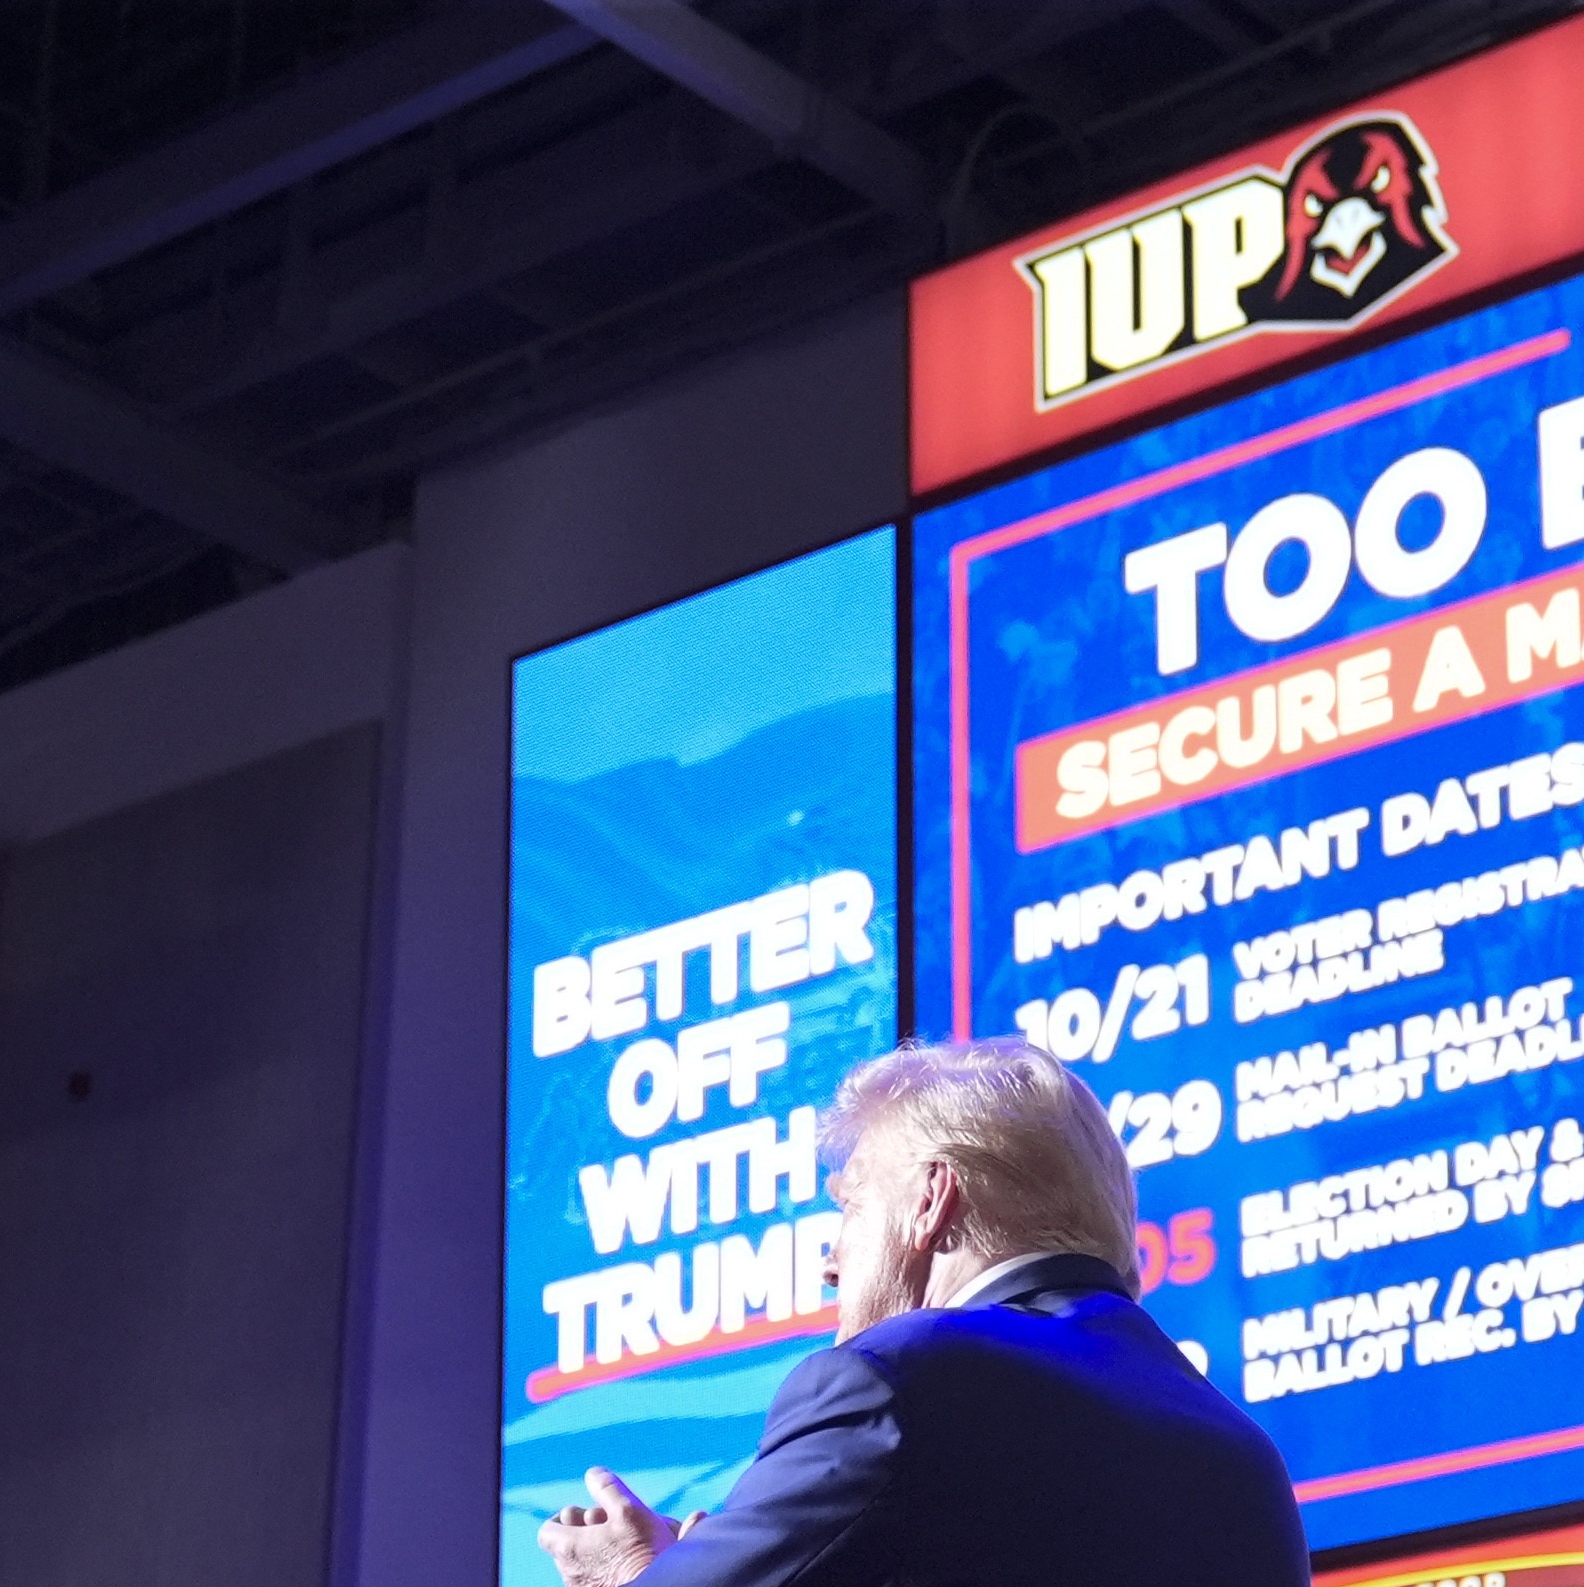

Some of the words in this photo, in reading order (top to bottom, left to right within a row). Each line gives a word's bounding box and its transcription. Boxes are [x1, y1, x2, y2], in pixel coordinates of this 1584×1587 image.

[1033, 178, 1285, 399] IUP
[1124, 446, 1487, 676] TOO
[1055, 650, 1394, 818] SECURE
[1413, 626, 1486, 714] A
[1013, 807, 1370, 964] IMPORTANT
[1232, 909, 1373, 980] VOTER
[532, 868, 875, 1059] BETTER
[1015, 953, 1210, 1064] 10/21
[1233, 927, 1445, 1025] DEADLINE
[608, 1001, 790, 1138] OFF
[1236, 1023, 1397, 1102] MAIL-IN
[1402, 977, 1574, 1060] BALLOT
[1107, 1079, 1223, 1169] /29
[1236, 1058, 1430, 1144] REQUEST
[579, 1105, 817, 1255] WITH
[1241, 1149, 1449, 1237] ELECTION
[1455, 1126, 1545, 1188] DAY
[1549, 1118, 1584, 1164] &
[1241, 1189, 1469, 1278] RETURNED
[1474, 1173, 1536, 1224] BY
[542, 1211, 843, 1375] TRUMP
[1243, 1277, 1439, 1360] MILITARY
[1443, 1267, 1472, 1320] /
[1243, 1336, 1409, 1404] BALLOT
[1415, 1307, 1516, 1368] REC.
[1522, 1289, 1584, 1345] BY
